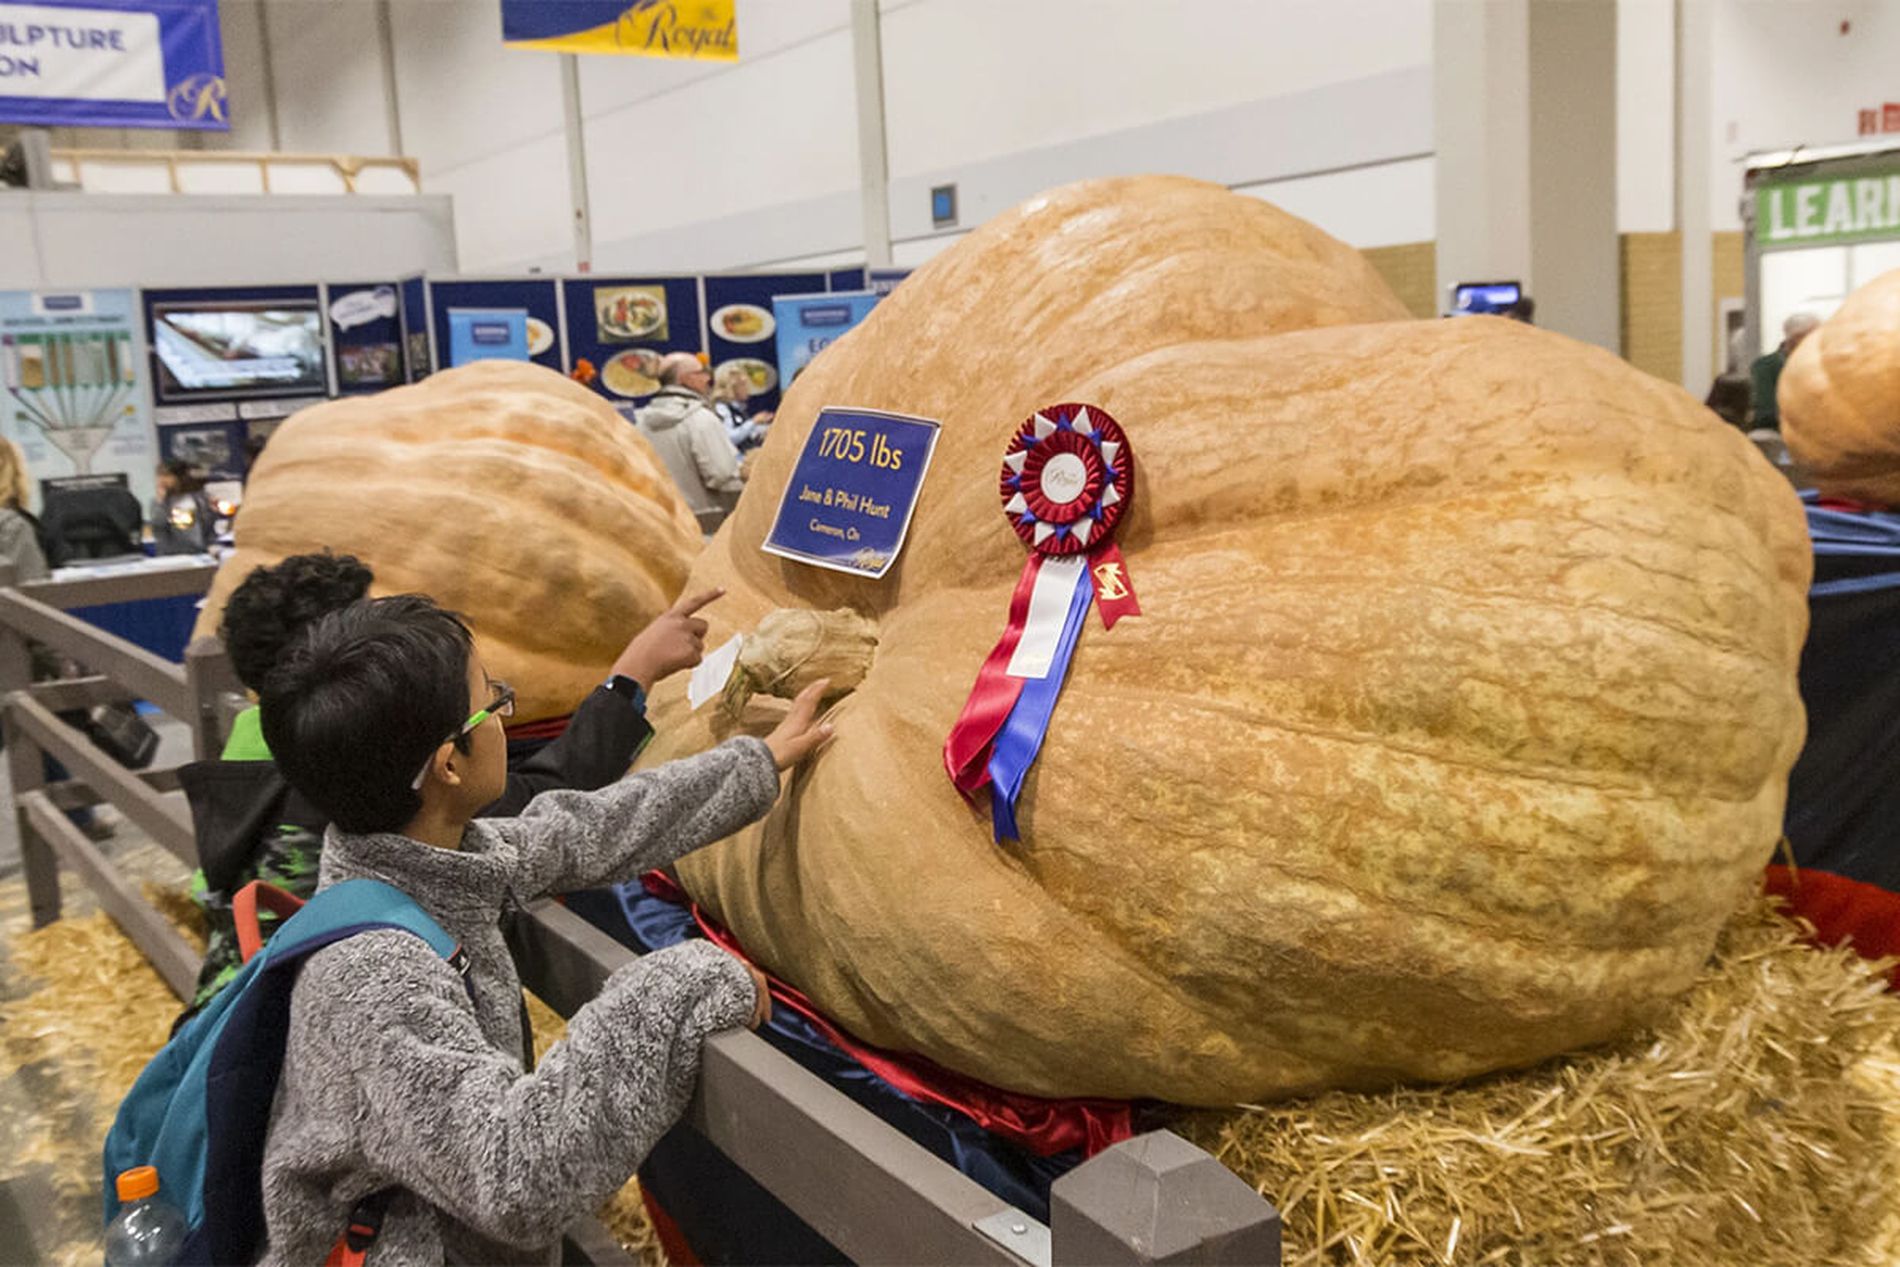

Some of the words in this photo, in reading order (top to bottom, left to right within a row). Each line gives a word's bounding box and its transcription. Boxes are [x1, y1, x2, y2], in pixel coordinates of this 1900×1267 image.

[615, 0, 735, 58] Royal
[818, 428, 866, 462] 1705
[870, 433, 903, 470] lbs
[823, 487, 833, 507] &
[835, 490, 859, 511] Phil
[859, 496, 891, 519] Hunt
